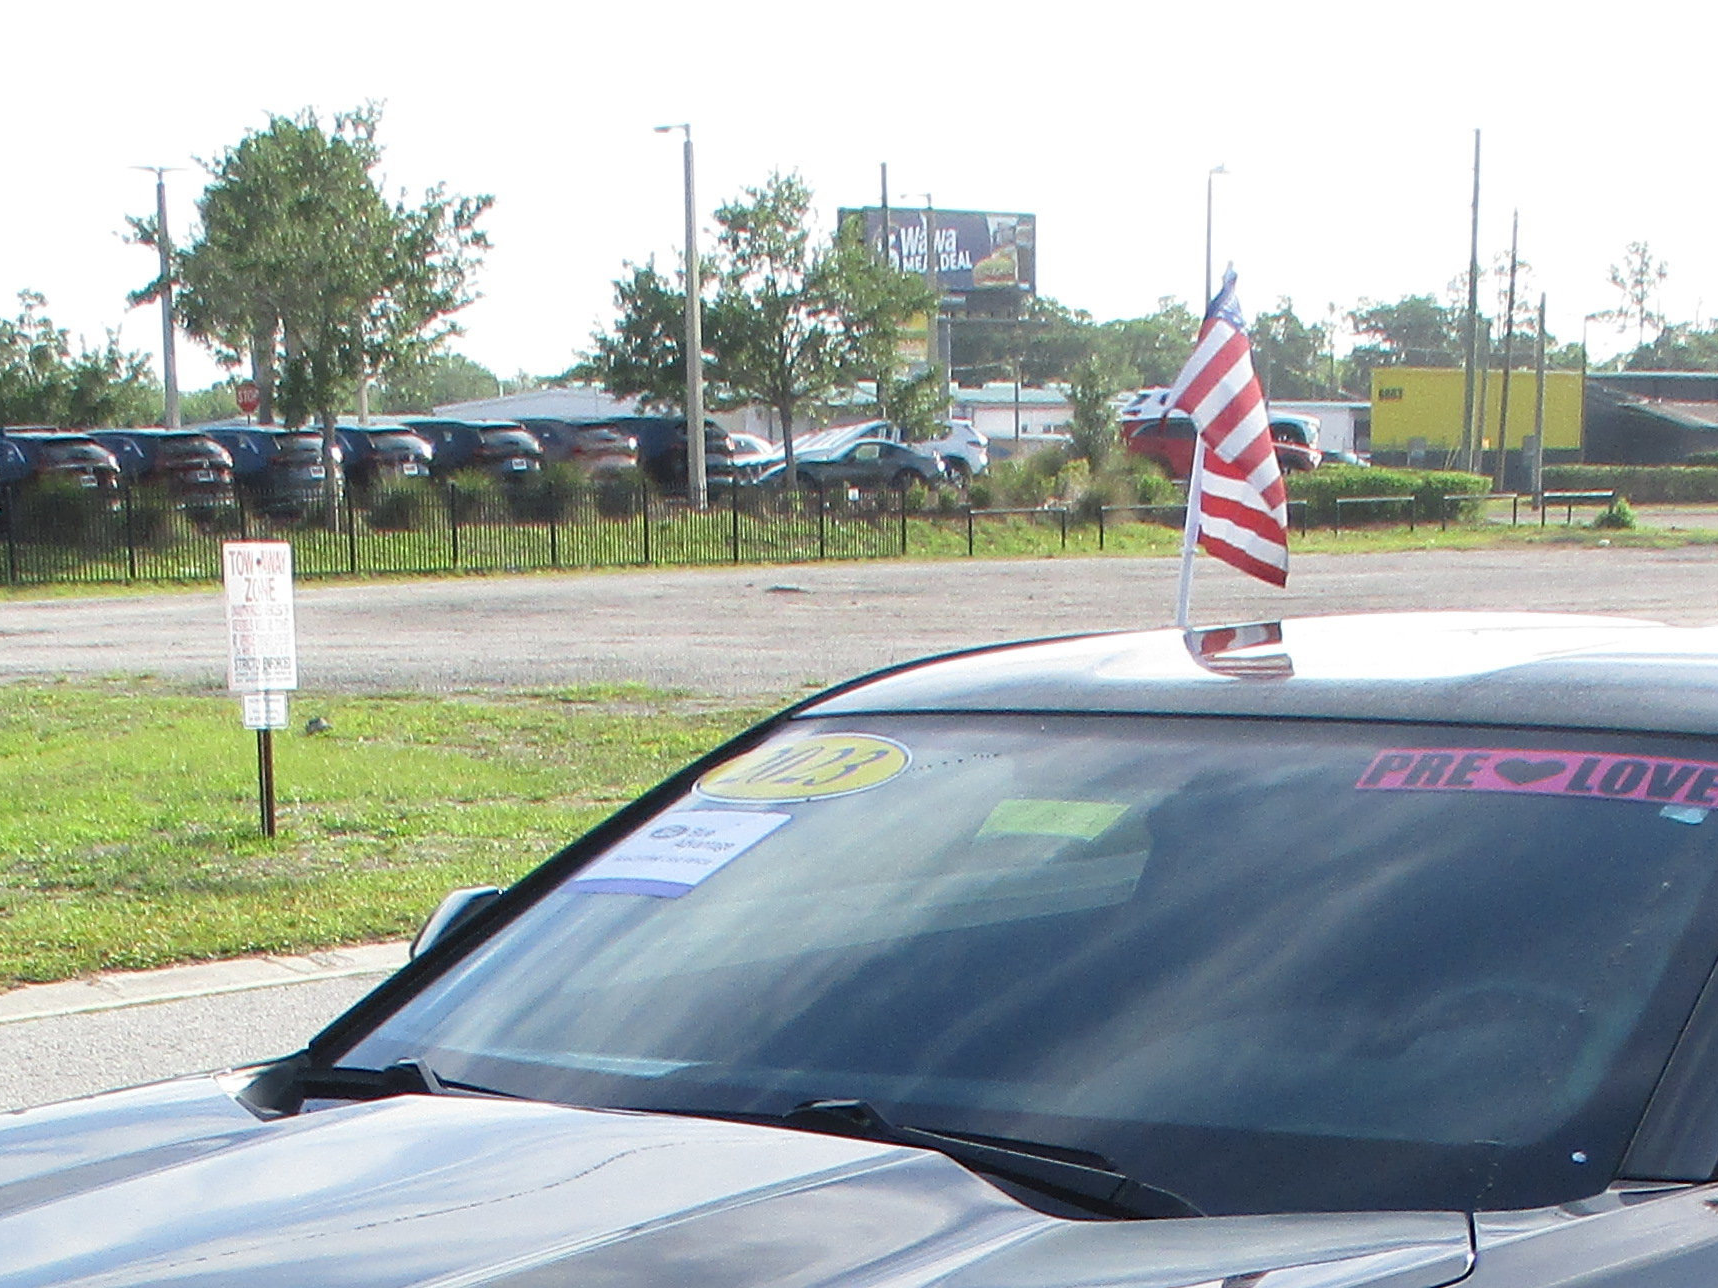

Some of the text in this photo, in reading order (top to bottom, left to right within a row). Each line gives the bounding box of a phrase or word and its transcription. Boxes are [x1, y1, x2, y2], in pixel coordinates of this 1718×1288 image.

[940, 251, 974, 273] DEAL
[244, 577, 277, 602] ZONE
[1366, 752, 1490, 789] PRE
